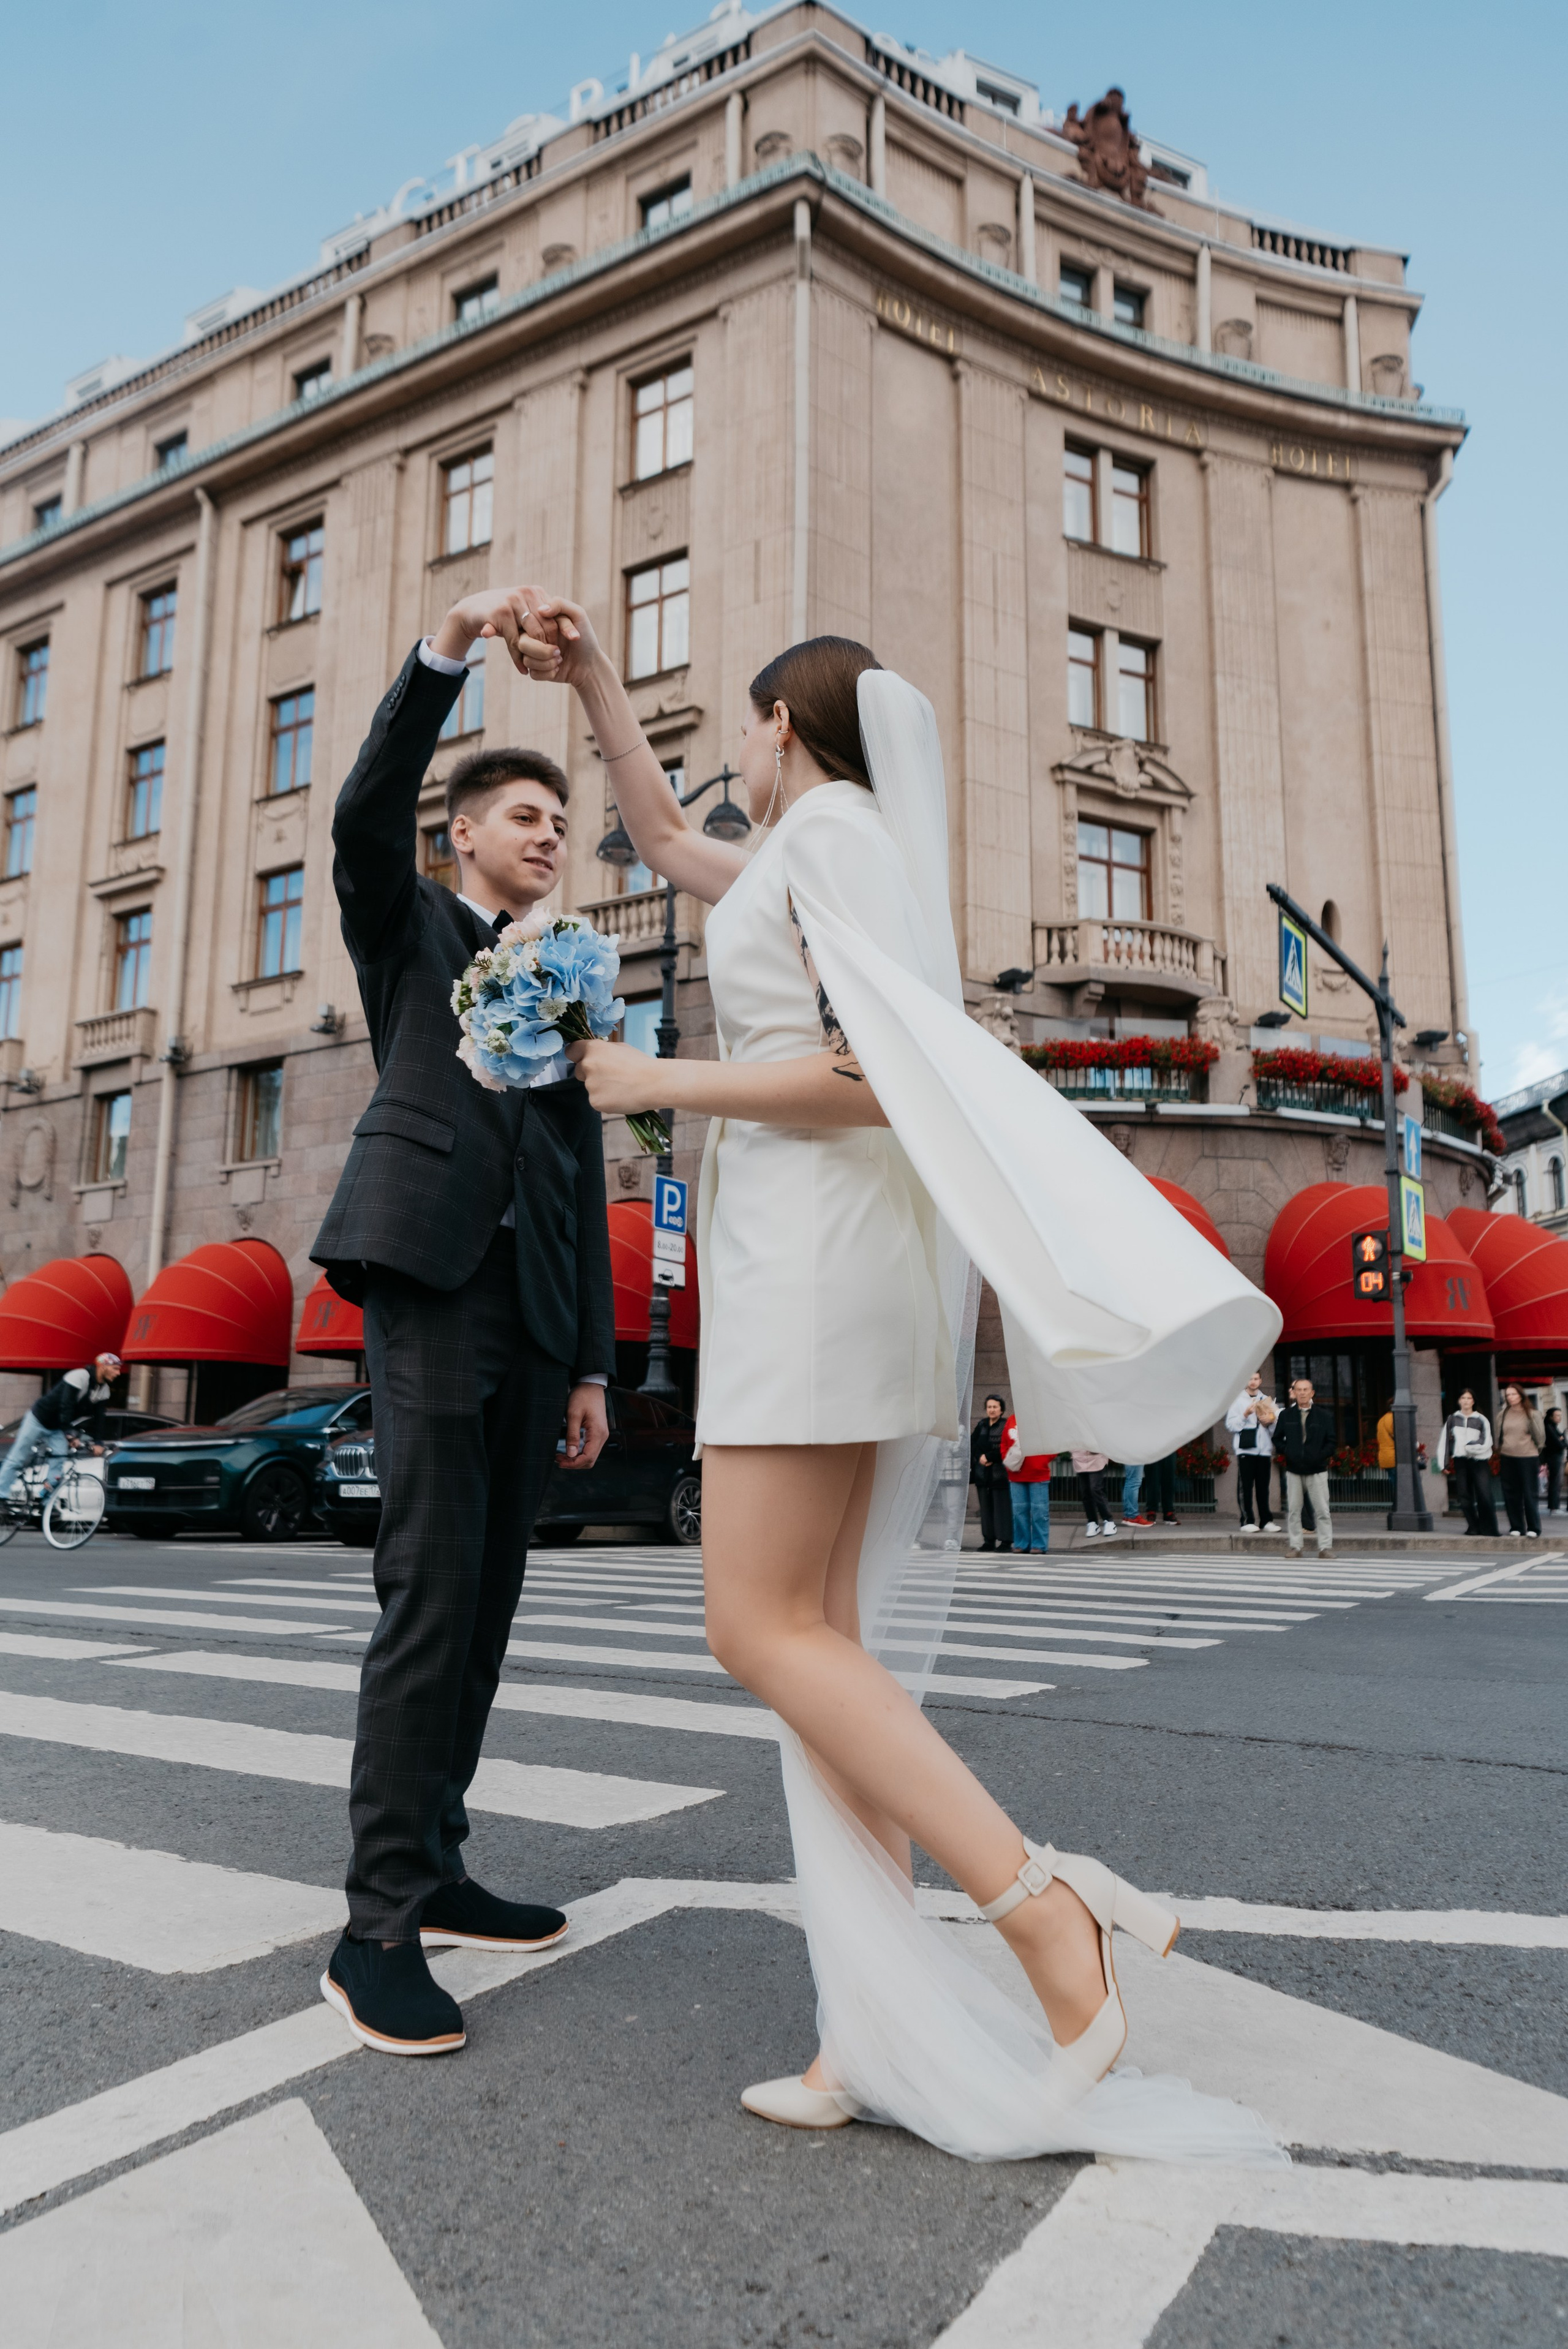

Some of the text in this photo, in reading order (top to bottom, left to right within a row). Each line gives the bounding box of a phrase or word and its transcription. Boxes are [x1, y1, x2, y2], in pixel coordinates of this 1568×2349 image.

[876, 296, 960, 354] HOTEL
[1031, 366, 1202, 445] ASTORIA
[1272, 443, 1354, 480] HOTEL
[663, 1183, 681, 1224] P
[657, 1240, 684, 1253] 8.00-20.00
[1360, 1272, 1384, 1292] 04
